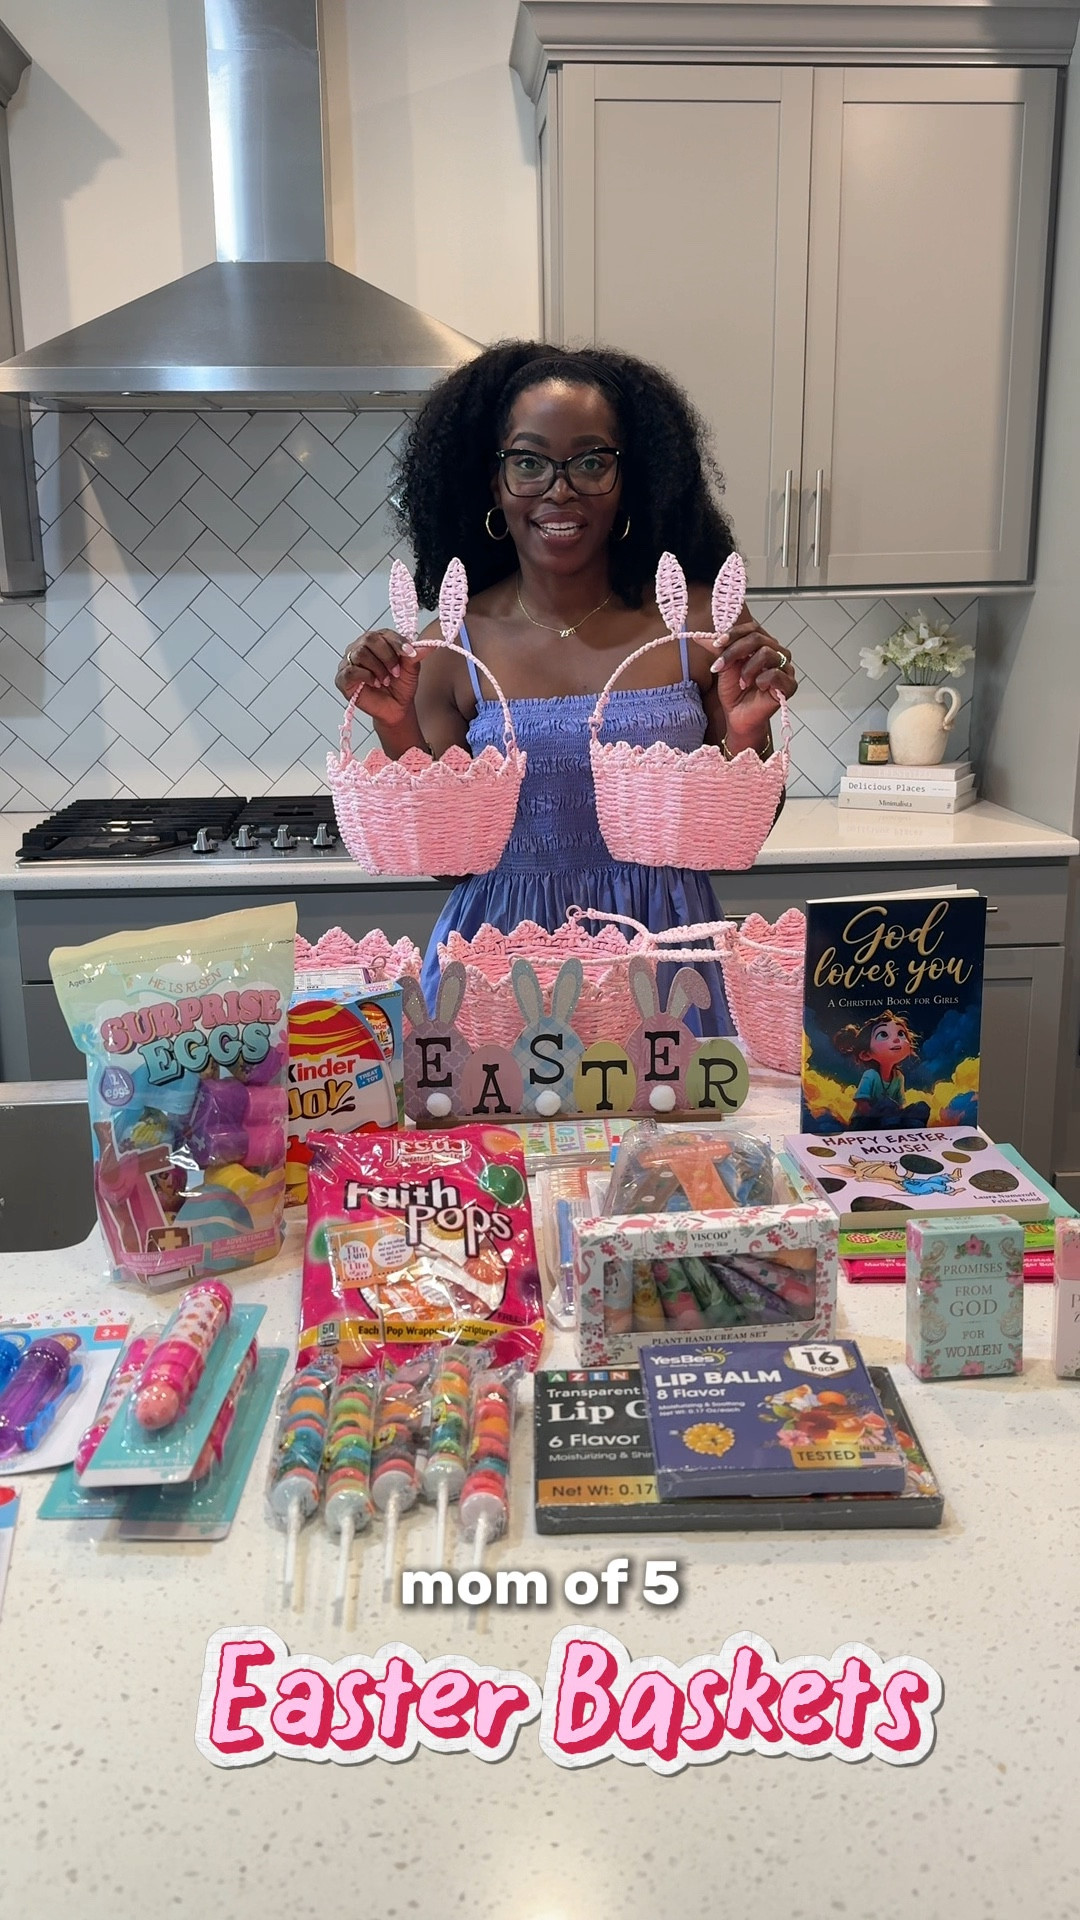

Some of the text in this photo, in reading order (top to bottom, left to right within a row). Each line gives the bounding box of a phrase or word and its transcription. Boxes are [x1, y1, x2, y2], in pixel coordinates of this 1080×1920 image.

[848, 782, 892, 792] Delicious
[896, 784, 926, 793] Places
[842, 901, 950, 964] God
[813, 947, 973, 994] loves you
[68, 980, 86, 988] Ages
[148, 967, 222, 993] HE IS RISEN
[827, 999, 836, 1008] A
[101, 989, 283, 1055] SURPRISE
[138, 1022, 271, 1087] EGGS
[358, 1068, 378, 1080] TREAT
[367, 1075, 379, 1084] TOY
[104, 1083, 131, 1099] eggs
[822, 1136, 878, 1146] HAPPY
[860, 1143, 932, 1155] MOUSE!
[345, 1176, 460, 1209] Faith
[406, 1203, 512, 1257] Pops
[943, 1262, 1003, 1275] PROMISES
[955, 1285, 993, 1297] FROM
[950, 1299, 998, 1317] GOD
[101, 1328, 119, 1337] 3+
[322, 1323, 335, 1333] 50
[358, 1325, 379, 1335] Each
[387, 1325, 404, 1337] Pop
[962, 1330, 985, 1339] FOR
[652, 1331, 768, 1345] PLANT HAND CREAM SET
[945, 1344, 1003, 1358] WOMEN
[801, 1351, 839, 1366] 16
[655, 1370, 782, 1387] LIP BALM
[546, 1386, 641, 1399] Transparent
[656, 1388, 726, 1401] 8 Flavor
[547, 1400, 615, 1425] Lip
[548, 1433, 641, 1448] 6 Flavor
[549, 1452, 617, 1462] Moisturizing
[797, 1450, 856, 1461] TESTED
[552, 1486, 581, 1497] Net
[587, 1485, 614, 1496] Wt:
